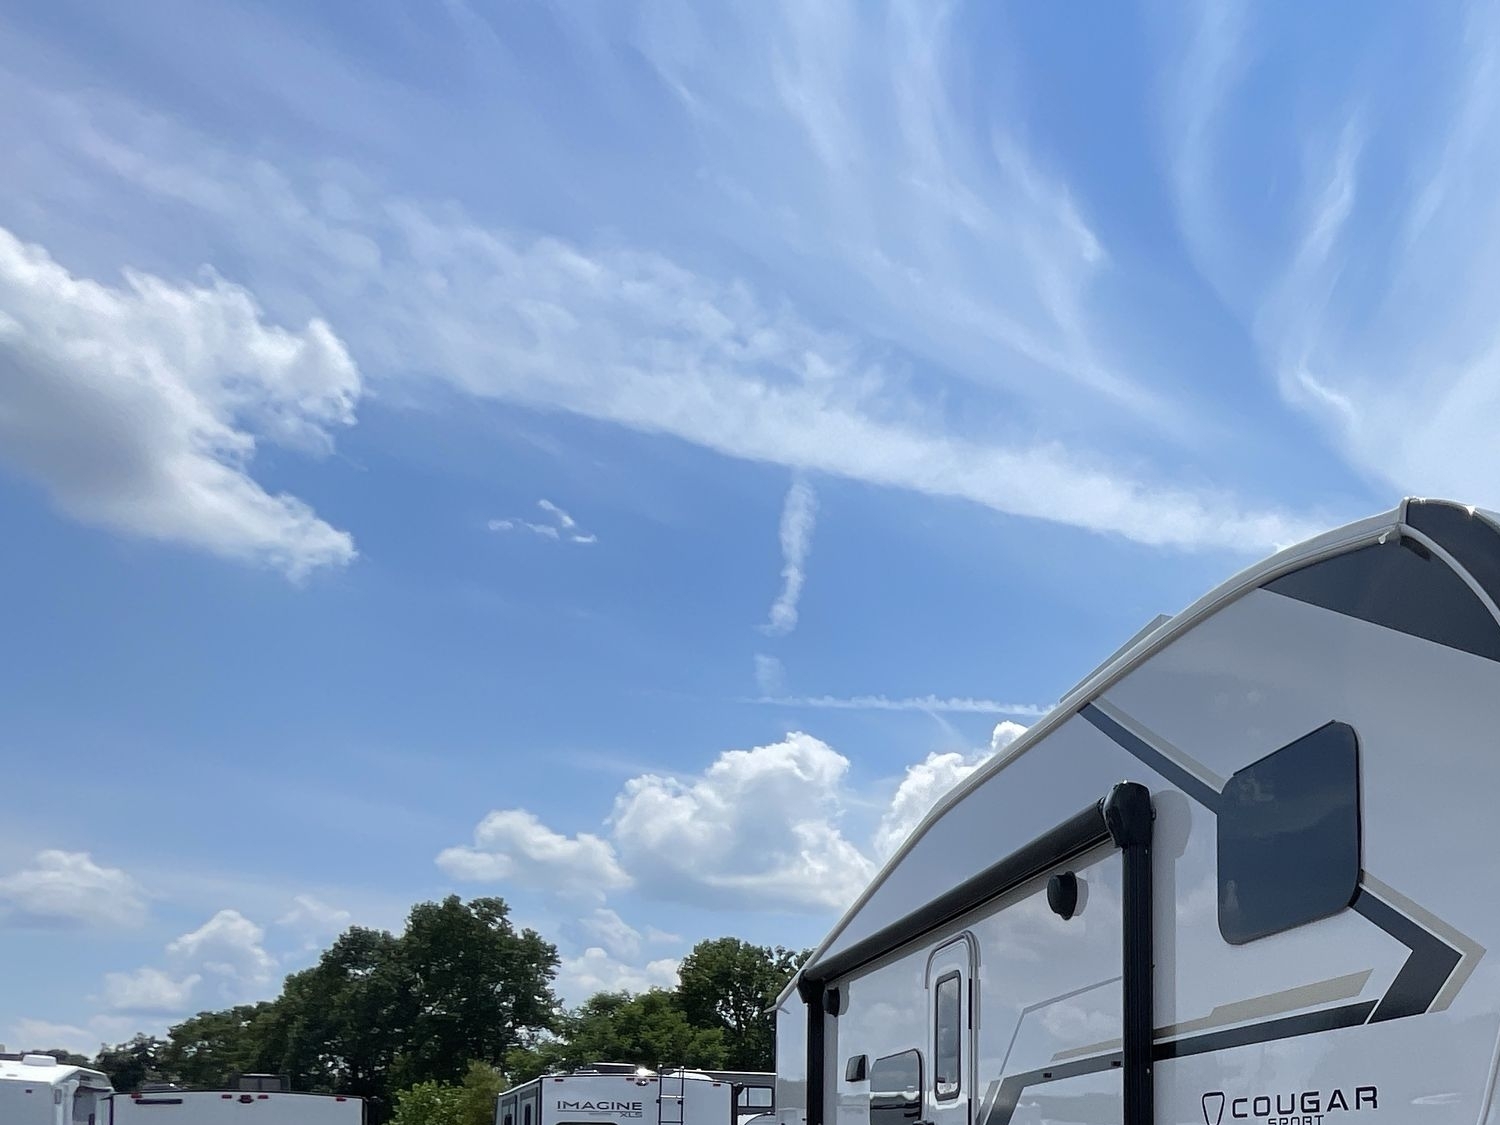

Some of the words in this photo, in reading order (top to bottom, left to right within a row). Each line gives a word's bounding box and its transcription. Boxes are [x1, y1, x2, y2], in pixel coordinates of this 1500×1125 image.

[556, 1100, 643, 1111] IMAGINE
[1231, 1086, 1379, 1119] COUGAR
[619, 1111, 644, 1119] XLS
